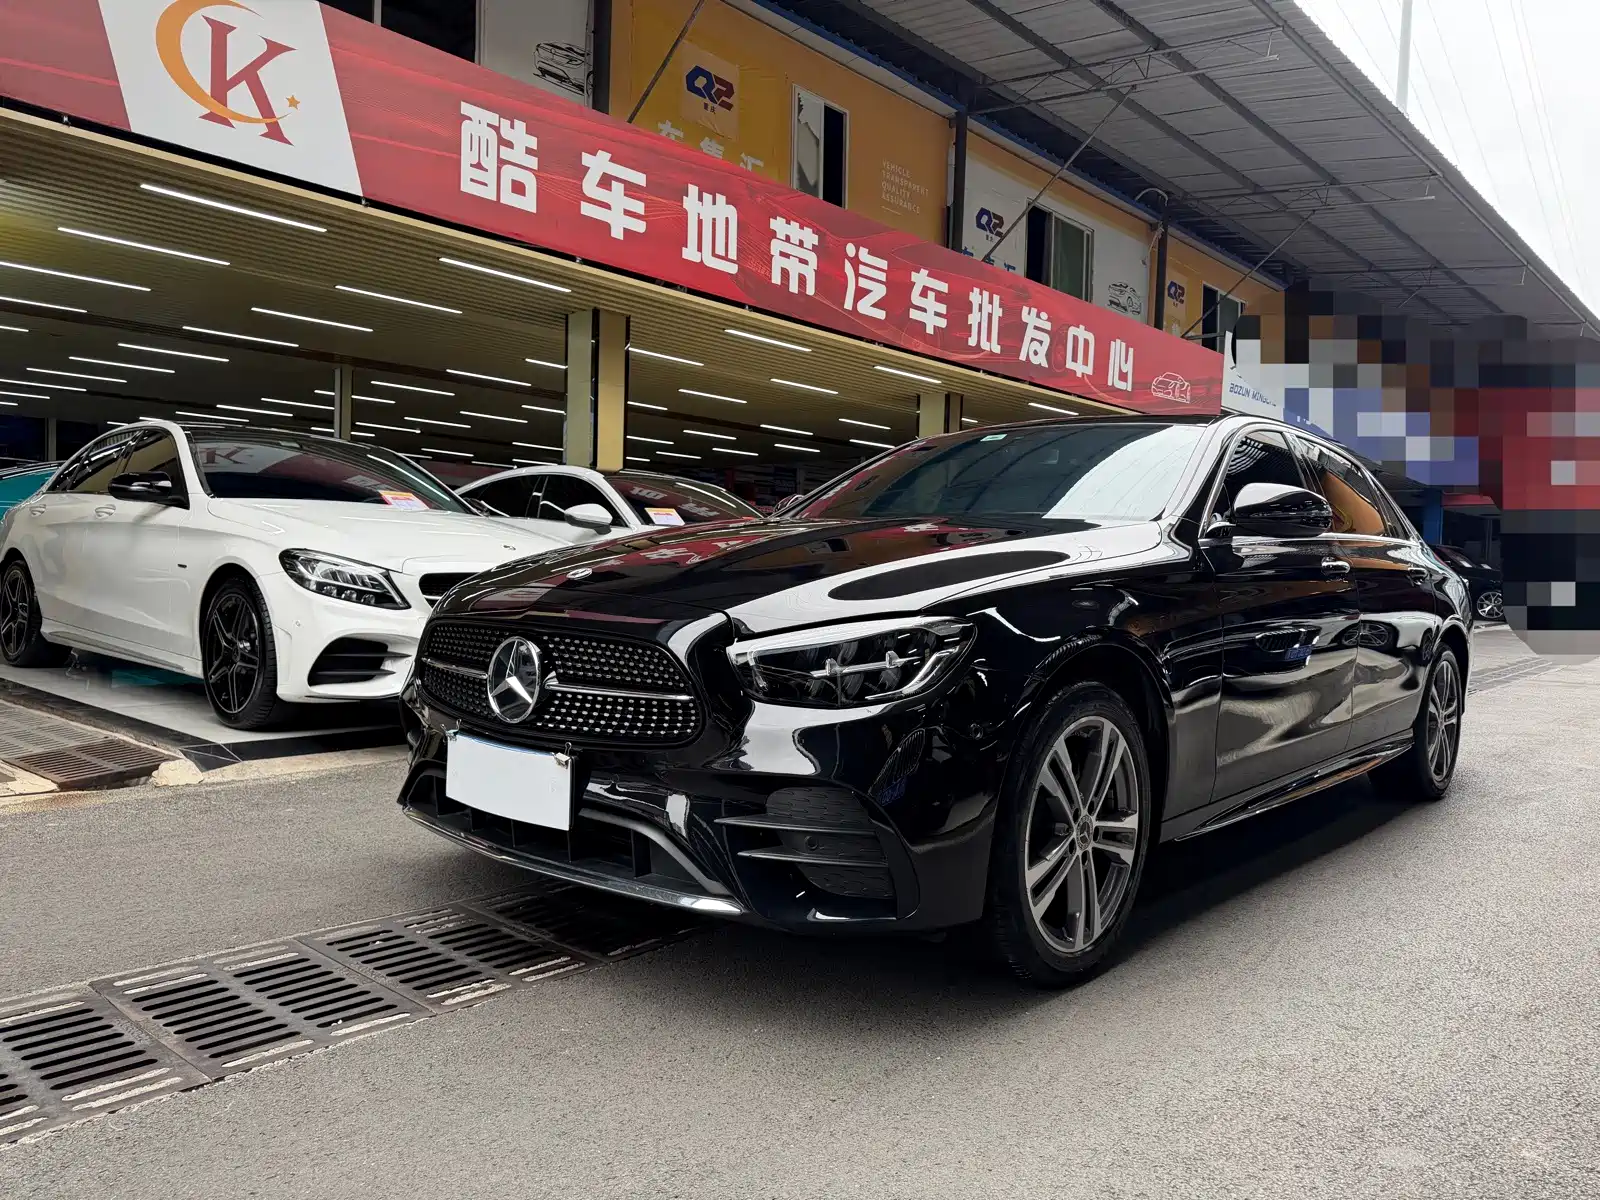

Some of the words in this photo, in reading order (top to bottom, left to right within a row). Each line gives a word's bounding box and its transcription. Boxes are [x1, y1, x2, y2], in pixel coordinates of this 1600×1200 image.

[460, 101, 1134, 392] 酷车地带汽车批发中心
